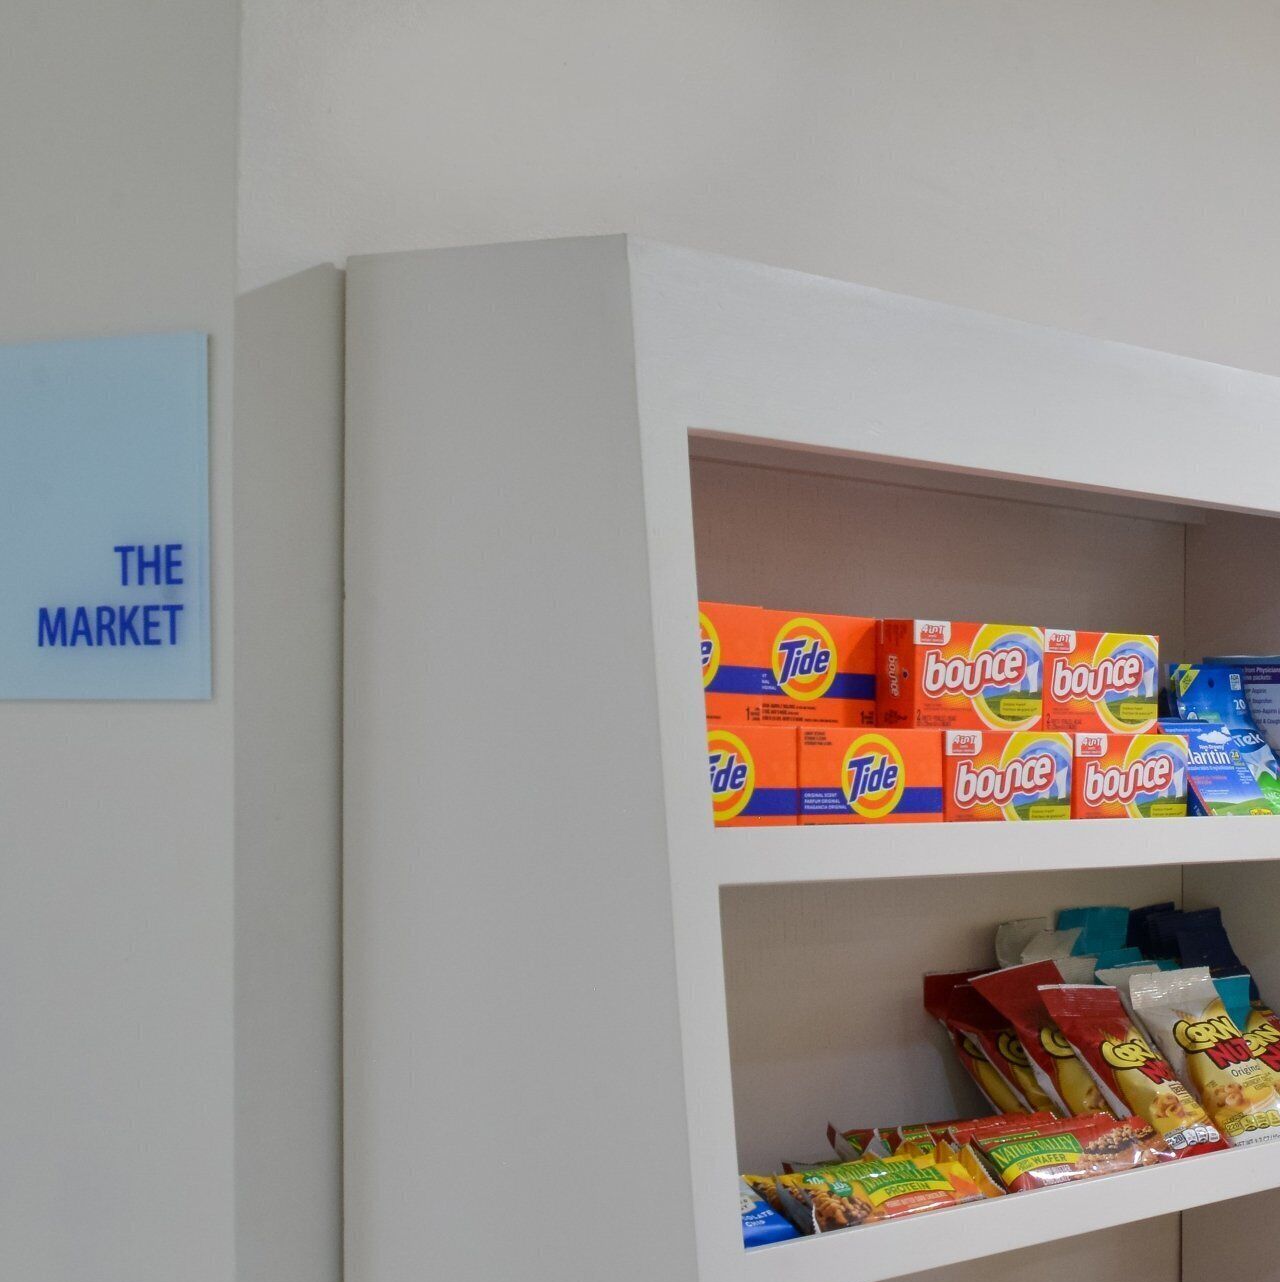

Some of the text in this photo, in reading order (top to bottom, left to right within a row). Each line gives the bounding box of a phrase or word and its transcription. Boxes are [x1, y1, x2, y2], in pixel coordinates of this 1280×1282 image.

[113, 544, 183, 586] THE
[38, 604, 184, 647] MARKET
[778, 638, 831, 687] Tide
[888, 655, 900, 697] bounce
[924, 648, 1026, 695] bounce
[1052, 656, 1142, 698] bounce
[847, 754, 899, 806] Tide
[956, 754, 1053, 803] bounce
[1084, 755, 1171, 803] bounce
[1173, 1015, 1244, 1053] CORN
[992, 1134, 1077, 1167] NATURE VALLEY
[1031, 1152, 1066, 1164] WAFER
[885, 1181, 931, 1197] PROTEIN
